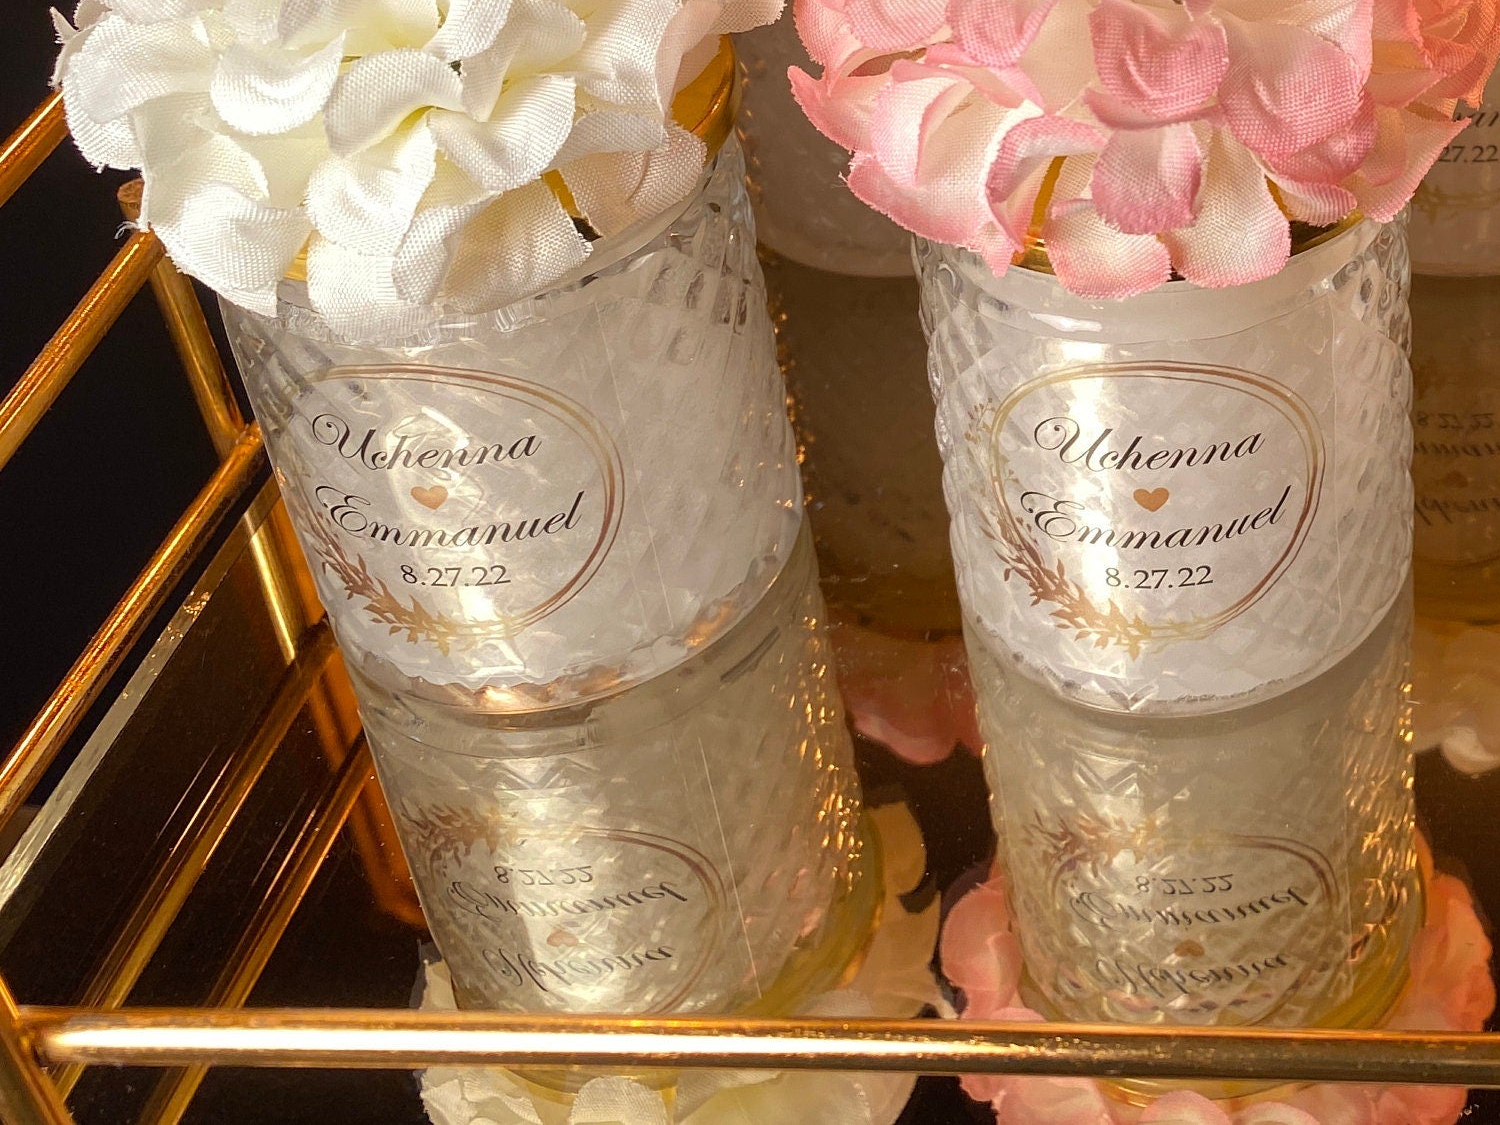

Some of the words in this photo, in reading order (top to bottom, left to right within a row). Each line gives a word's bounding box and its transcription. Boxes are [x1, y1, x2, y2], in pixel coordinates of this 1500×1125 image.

[311, 413, 543, 471] Uchenna
[1034, 416, 1266, 472] Uchenna
[315, 485, 584, 547] Emmanuel
[1020, 485, 1292, 549] Emmanuel
[400, 564, 511, 587] 8.27.22
[1105, 565, 1213, 590] 8.27.22
